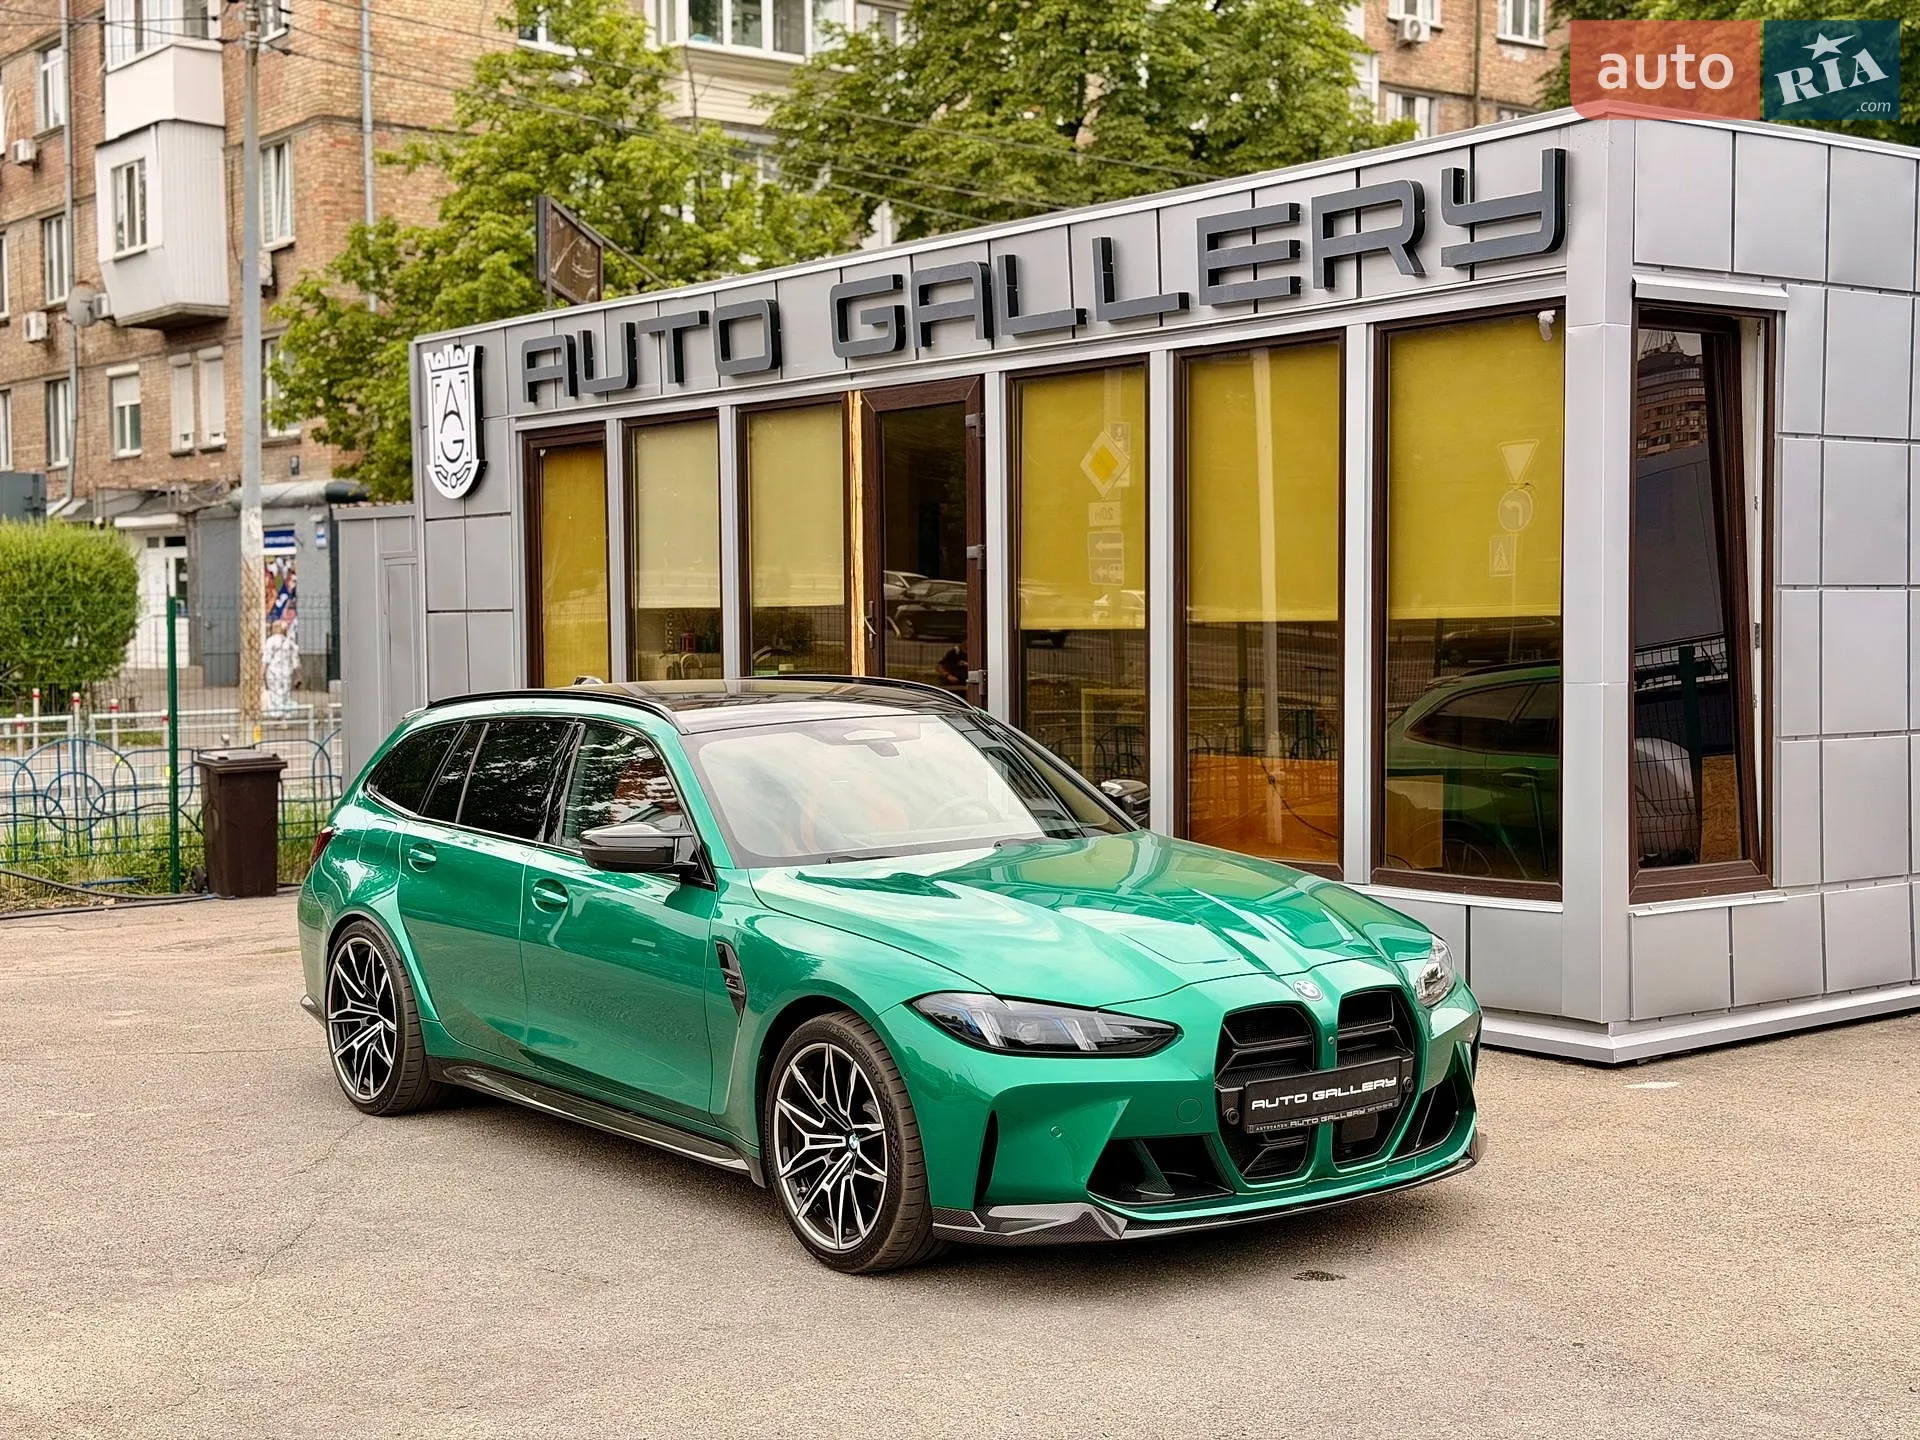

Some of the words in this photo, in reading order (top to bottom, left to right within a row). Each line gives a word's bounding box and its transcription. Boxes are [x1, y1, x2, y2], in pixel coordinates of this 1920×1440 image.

[521, 299, 780, 403] AUTO
[830, 147, 1567, 358] GALLERY
[1251, 1093, 1308, 1111] AUTO
[1312, 1076, 1397, 1102] GALLERY
[1290, 1116, 1319, 1127] AUTO
[1320, 1108, 1366, 1123] GALLERY
